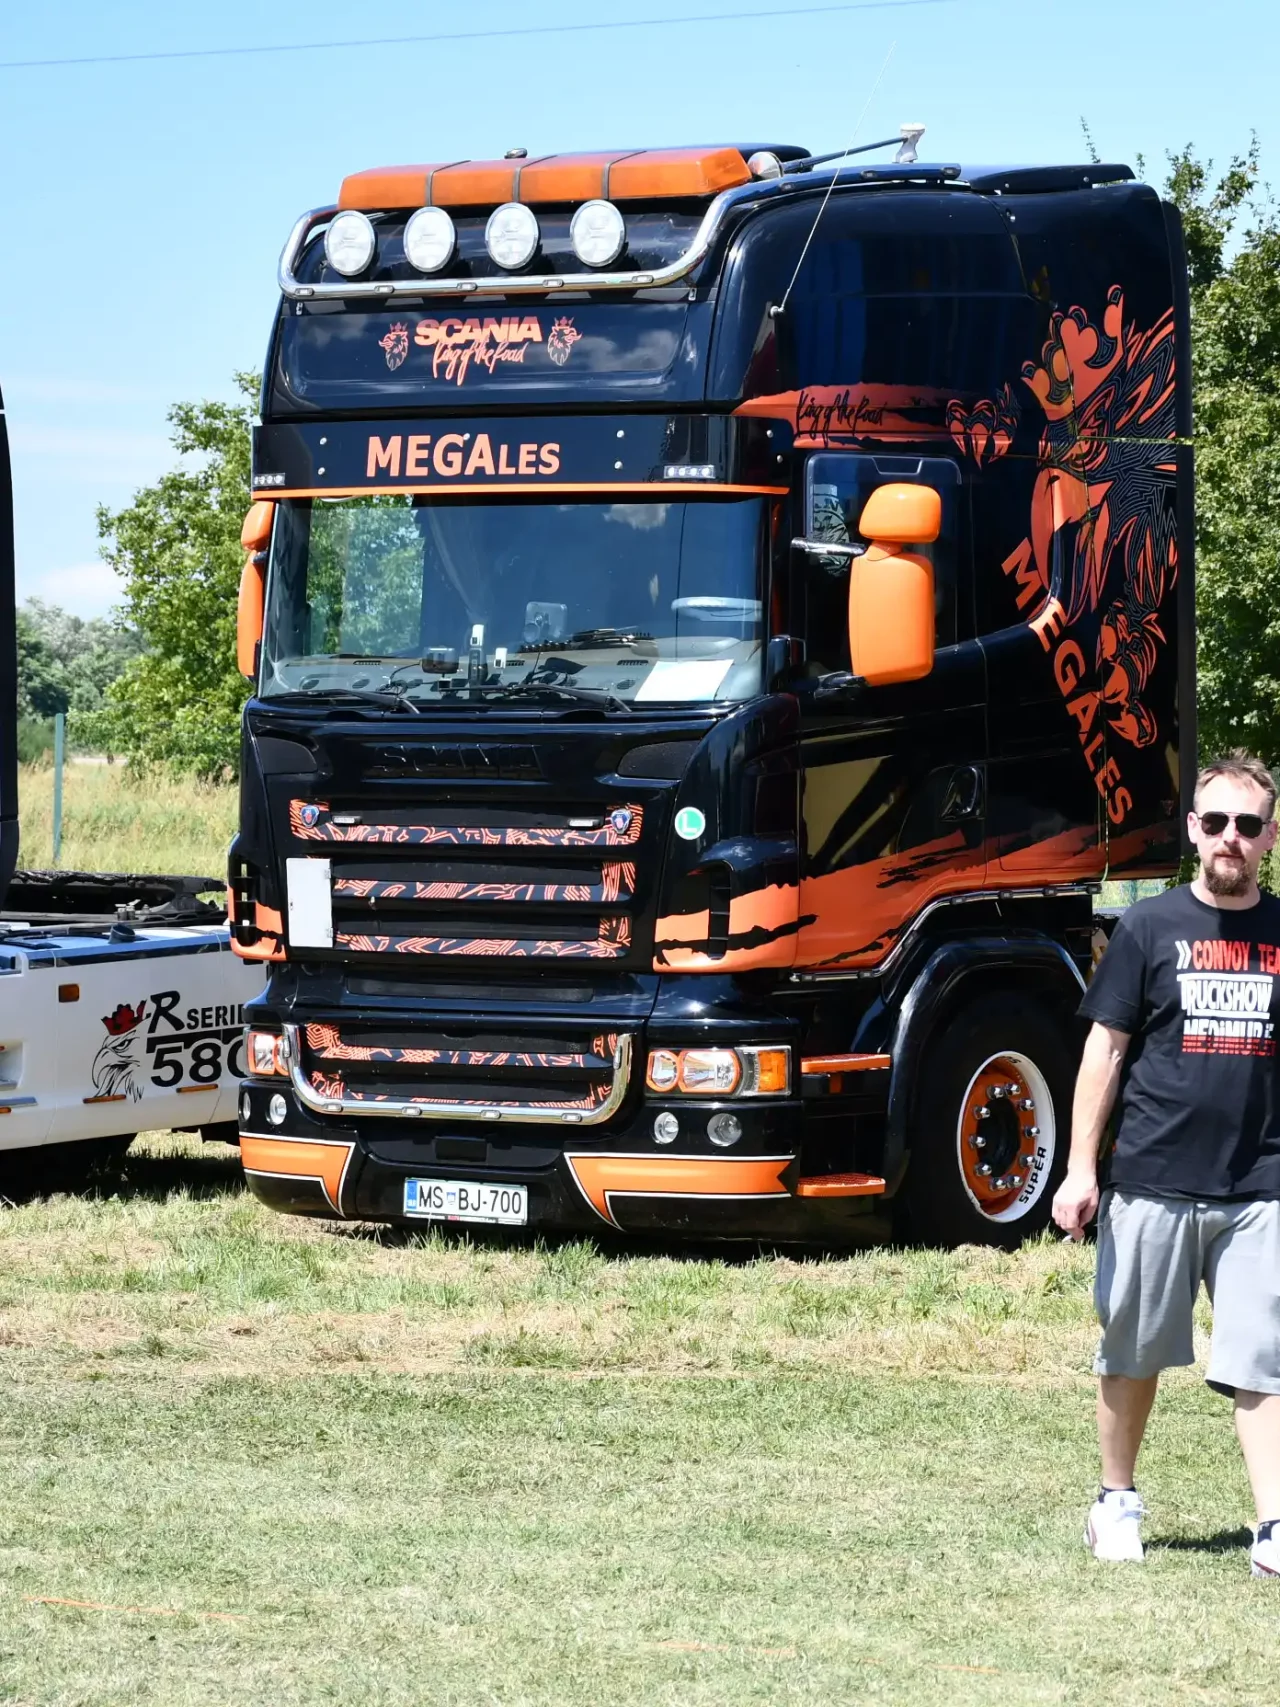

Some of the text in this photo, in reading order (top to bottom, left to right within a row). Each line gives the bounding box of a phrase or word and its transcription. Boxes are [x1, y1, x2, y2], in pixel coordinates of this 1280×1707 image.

[414, 316, 543, 345] SCANIA
[366, 433, 560, 477] MEGALES
[1001, 537, 1133, 824] MEGALES
[1192, 940, 1251, 971] CONVOY
[147, 990, 185, 1034] R
[1177, 973, 1273, 1019] TRUCKSHOW
[1019, 1146, 1047, 1204] SUPER
[419, 1185, 521, 1214] MS BJ-700
